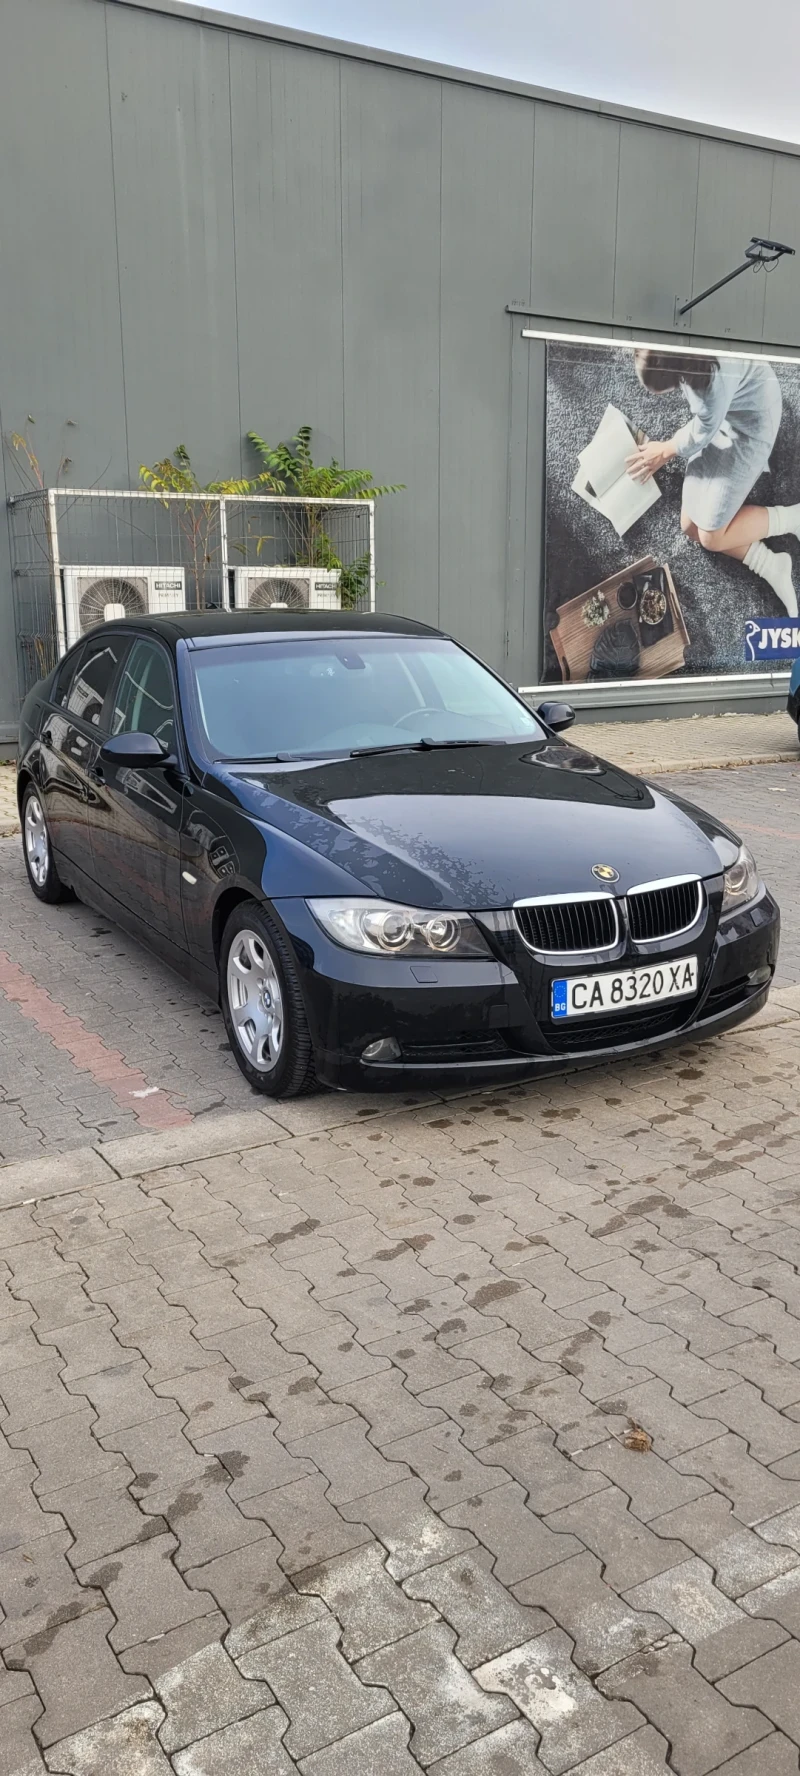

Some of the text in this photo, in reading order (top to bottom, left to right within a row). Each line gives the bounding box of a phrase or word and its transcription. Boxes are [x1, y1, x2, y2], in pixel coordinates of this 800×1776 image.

[758, 627, 800, 649] JYSK
[571, 962, 693, 1010] CA 8320 XA
[554, 1002, 566, 1012] BG
